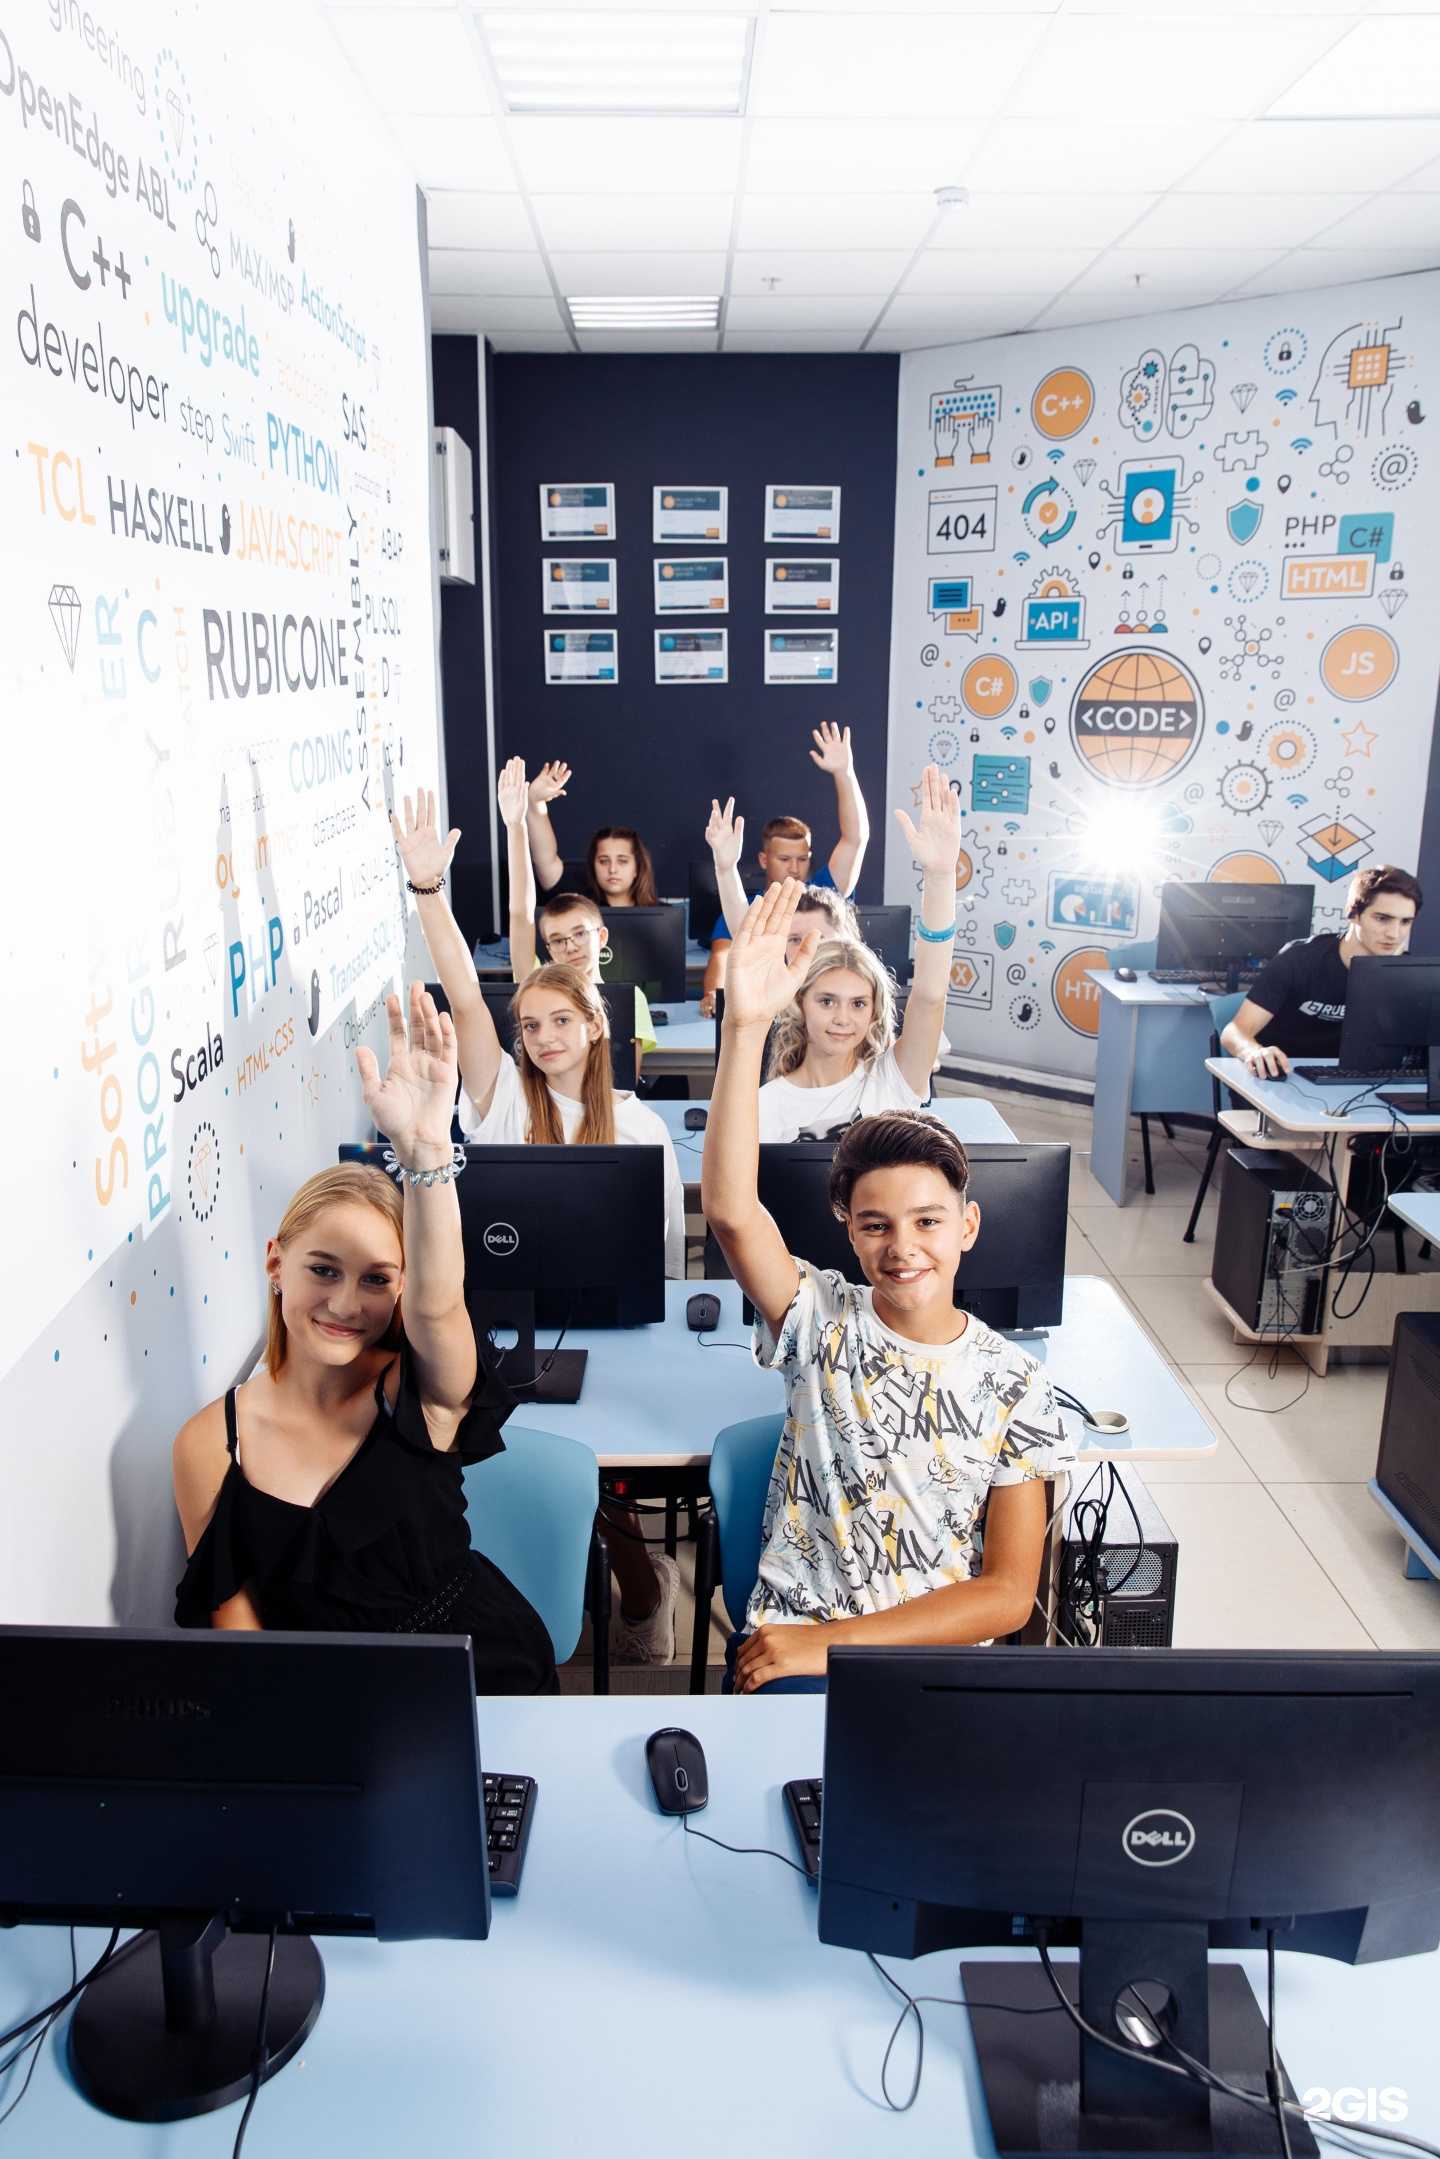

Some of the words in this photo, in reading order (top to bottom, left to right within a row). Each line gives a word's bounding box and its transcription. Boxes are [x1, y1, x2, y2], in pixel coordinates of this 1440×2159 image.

[136, 157, 176, 232] ABL
[60, 198, 131, 300] C++
[17, 283, 169, 429] developer
[161, 271, 260, 377] upgrade
[180, 396, 214, 454] step
[221, 411, 256, 467] Swift
[342, 392, 367, 451] SAS
[1040, 394, 1085, 417] C++
[28, 441, 96, 526] TCL
[266, 411, 341, 498] PYTHON
[107, 475, 213, 554] HASKELL
[236, 500, 346, 576] JAVASCRIPT
[935, 512, 988, 541] 404
[1285, 514, 1337, 538] PHP
[1348, 525, 1385, 549] C#
[1291, 564, 1364, 589] HTML
[202, 608, 349, 701] RUBICONE
[1034, 610, 1069, 632] API
[975, 676, 1004, 698] C#
[1342, 651, 1375, 676] JS
[288, 727, 354, 794] CODING
[303, 867, 343, 938] Pascal
[228, 916, 284, 1018] PHP
[171, 1021, 224, 1103] Scala
[238, 1017, 295, 1097] HTML+CSS
[487, 1235, 515, 1244] DELL
[1130, 1830, 1187, 1846] DELL
